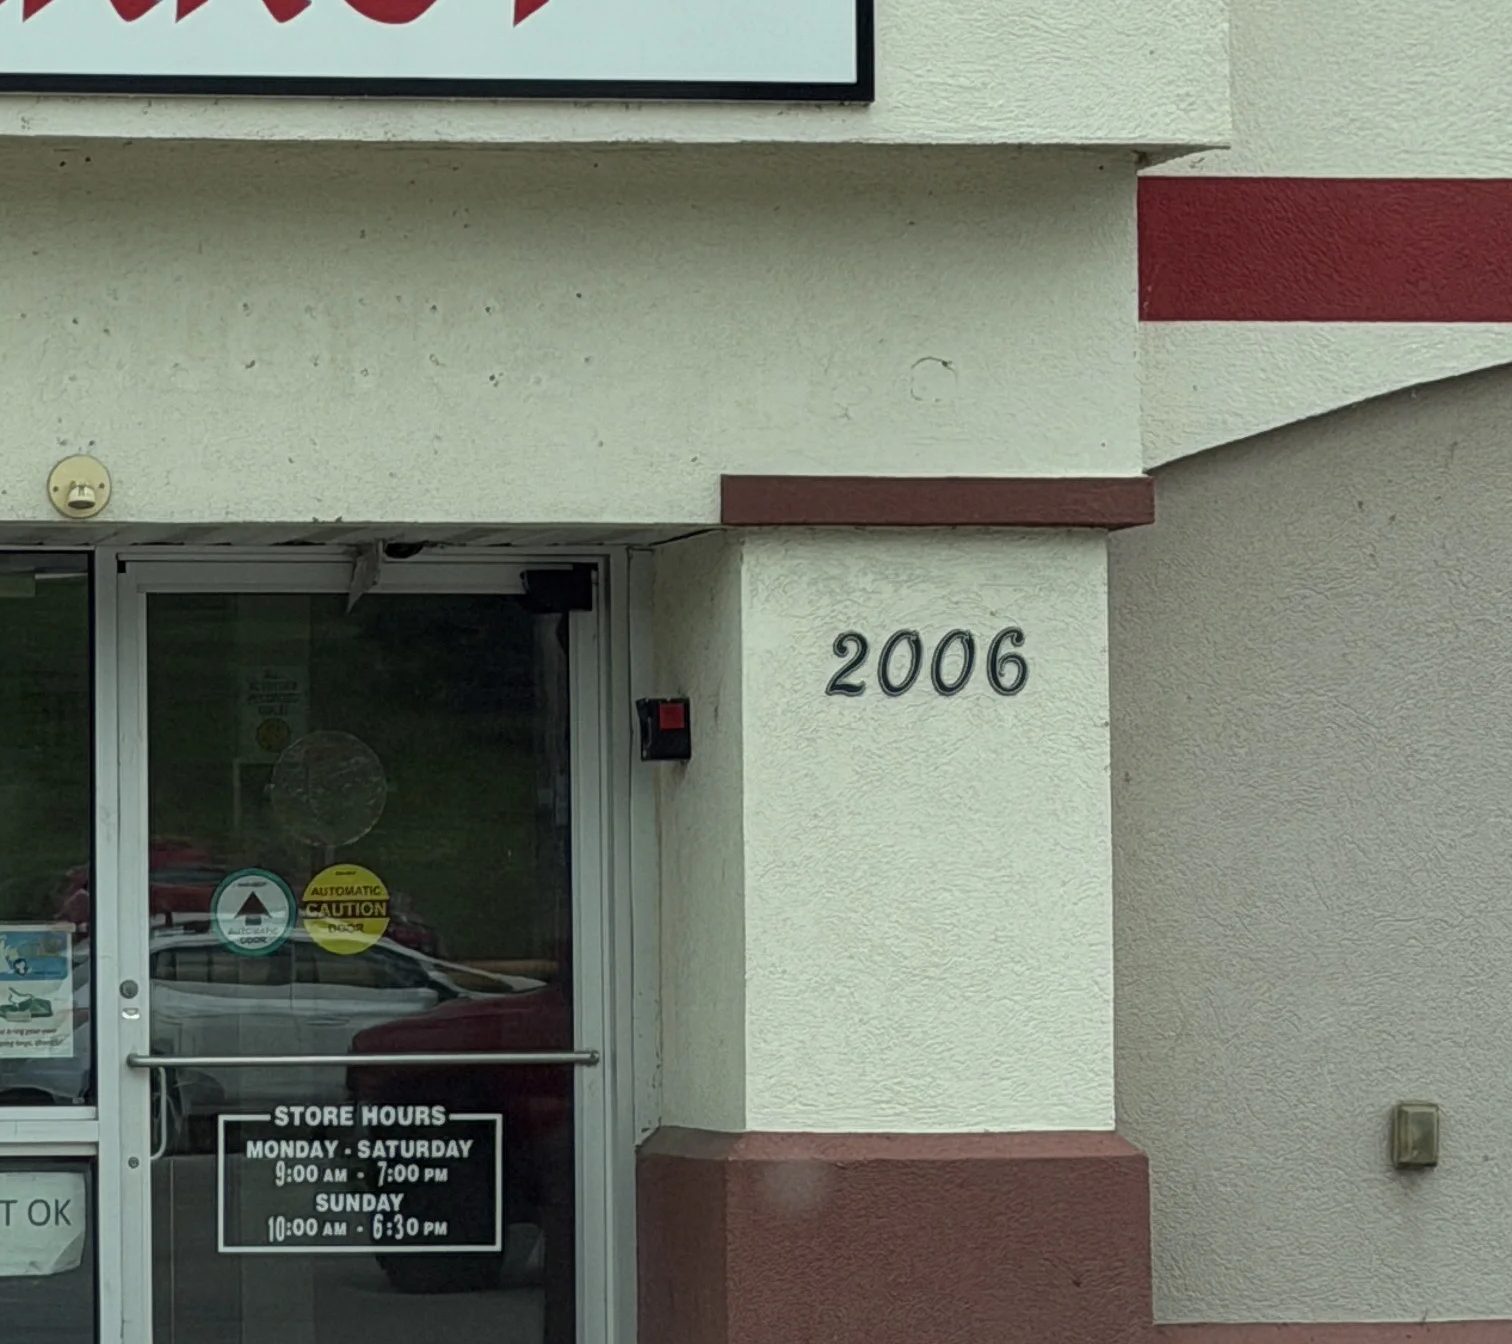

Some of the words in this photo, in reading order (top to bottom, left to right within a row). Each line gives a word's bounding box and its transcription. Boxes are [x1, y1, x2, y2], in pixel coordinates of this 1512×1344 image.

[824, 626, 1030, 698] 2006
[311, 885, 381, 897] AUTOMATIC
[306, 902, 387, 917] CAUTION
[328, 923, 365, 933] DOOR
[274, 1106, 354, 1126] STORE
[362, 1106, 447, 1126] HOURS
[246, 1140, 339, 1158] MONDAY
[357, 1139, 474, 1158] SATURDAY
[275, 1161, 318, 1187] 9:00
[323, 1168, 348, 1182] AM
[377, 1161, 419, 1187] 7:00
[423, 1168, 448, 1182] PM
[315, 1193, 404, 1212] SUNDAY
[28, 1198, 72, 1227] OK
[268, 1216, 318, 1242] 10:00
[322, 1221, 348, 1236] AM
[372, 1213, 419, 1240] 6:30
[423, 1221, 448, 1236] PM
